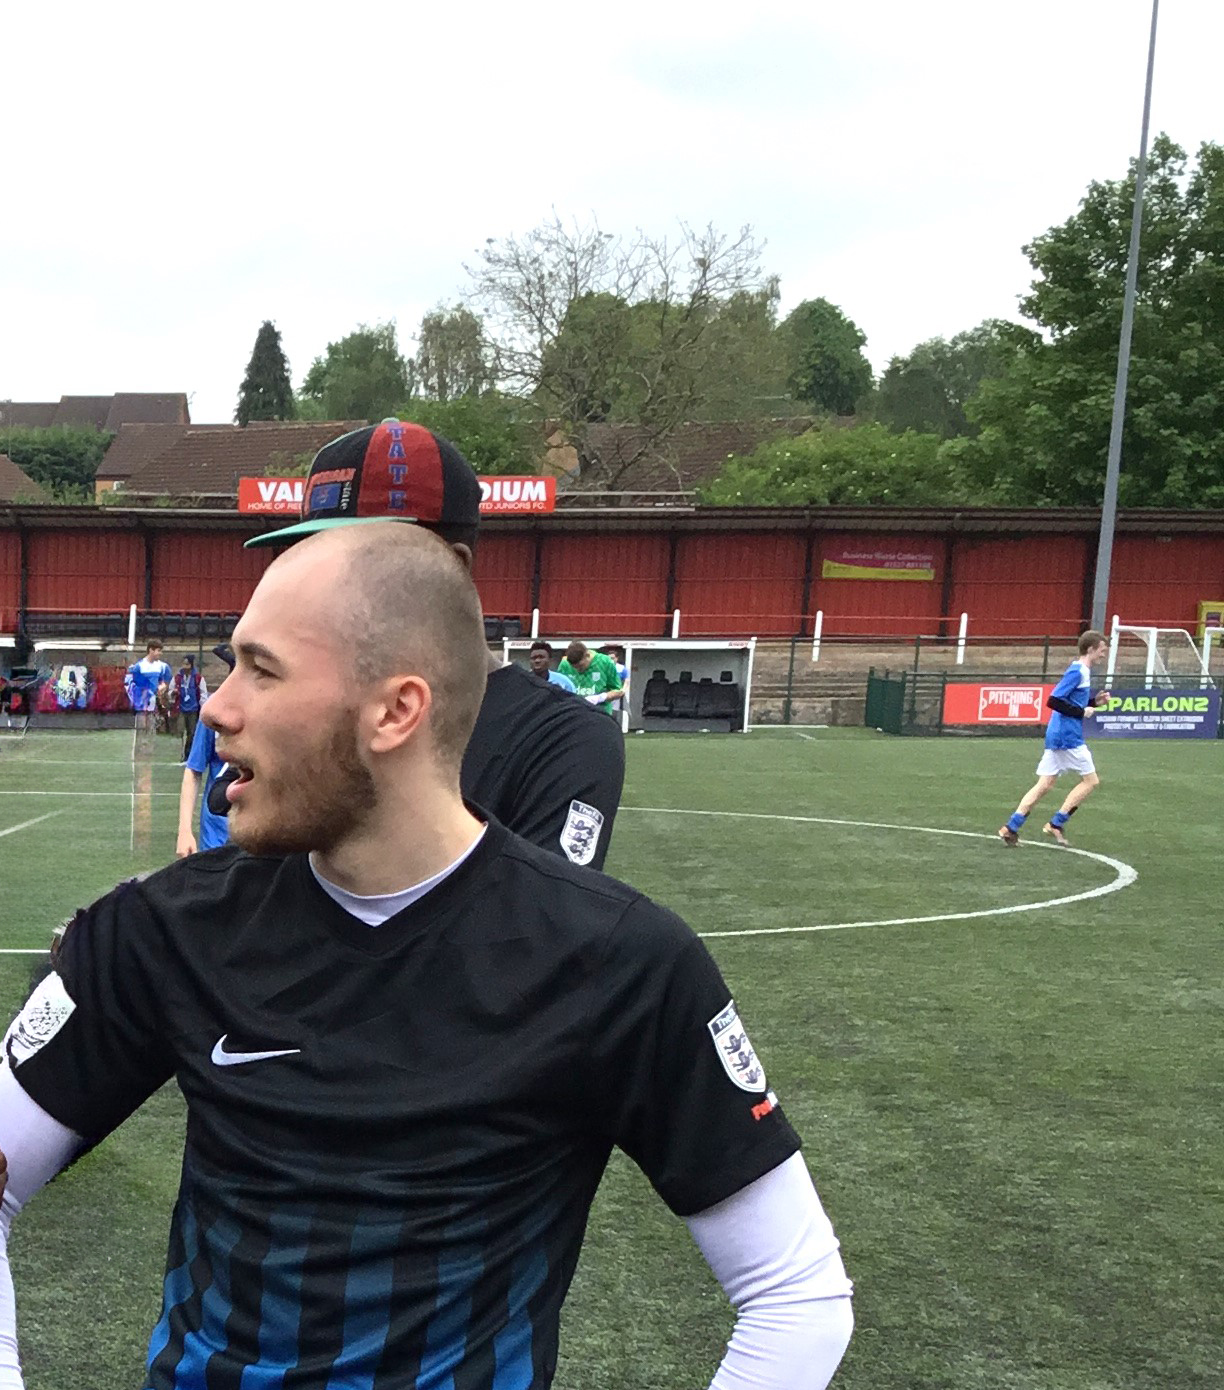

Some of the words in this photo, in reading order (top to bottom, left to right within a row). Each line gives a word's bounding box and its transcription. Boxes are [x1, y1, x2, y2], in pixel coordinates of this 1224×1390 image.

[248, 502, 273, 511] HOME
[274, 502, 285, 511] OF
[494, 502, 531, 510] JUNIORS
[988, 691, 1034, 704] PITCHING
[1008, 704, 1020, 717] IN
